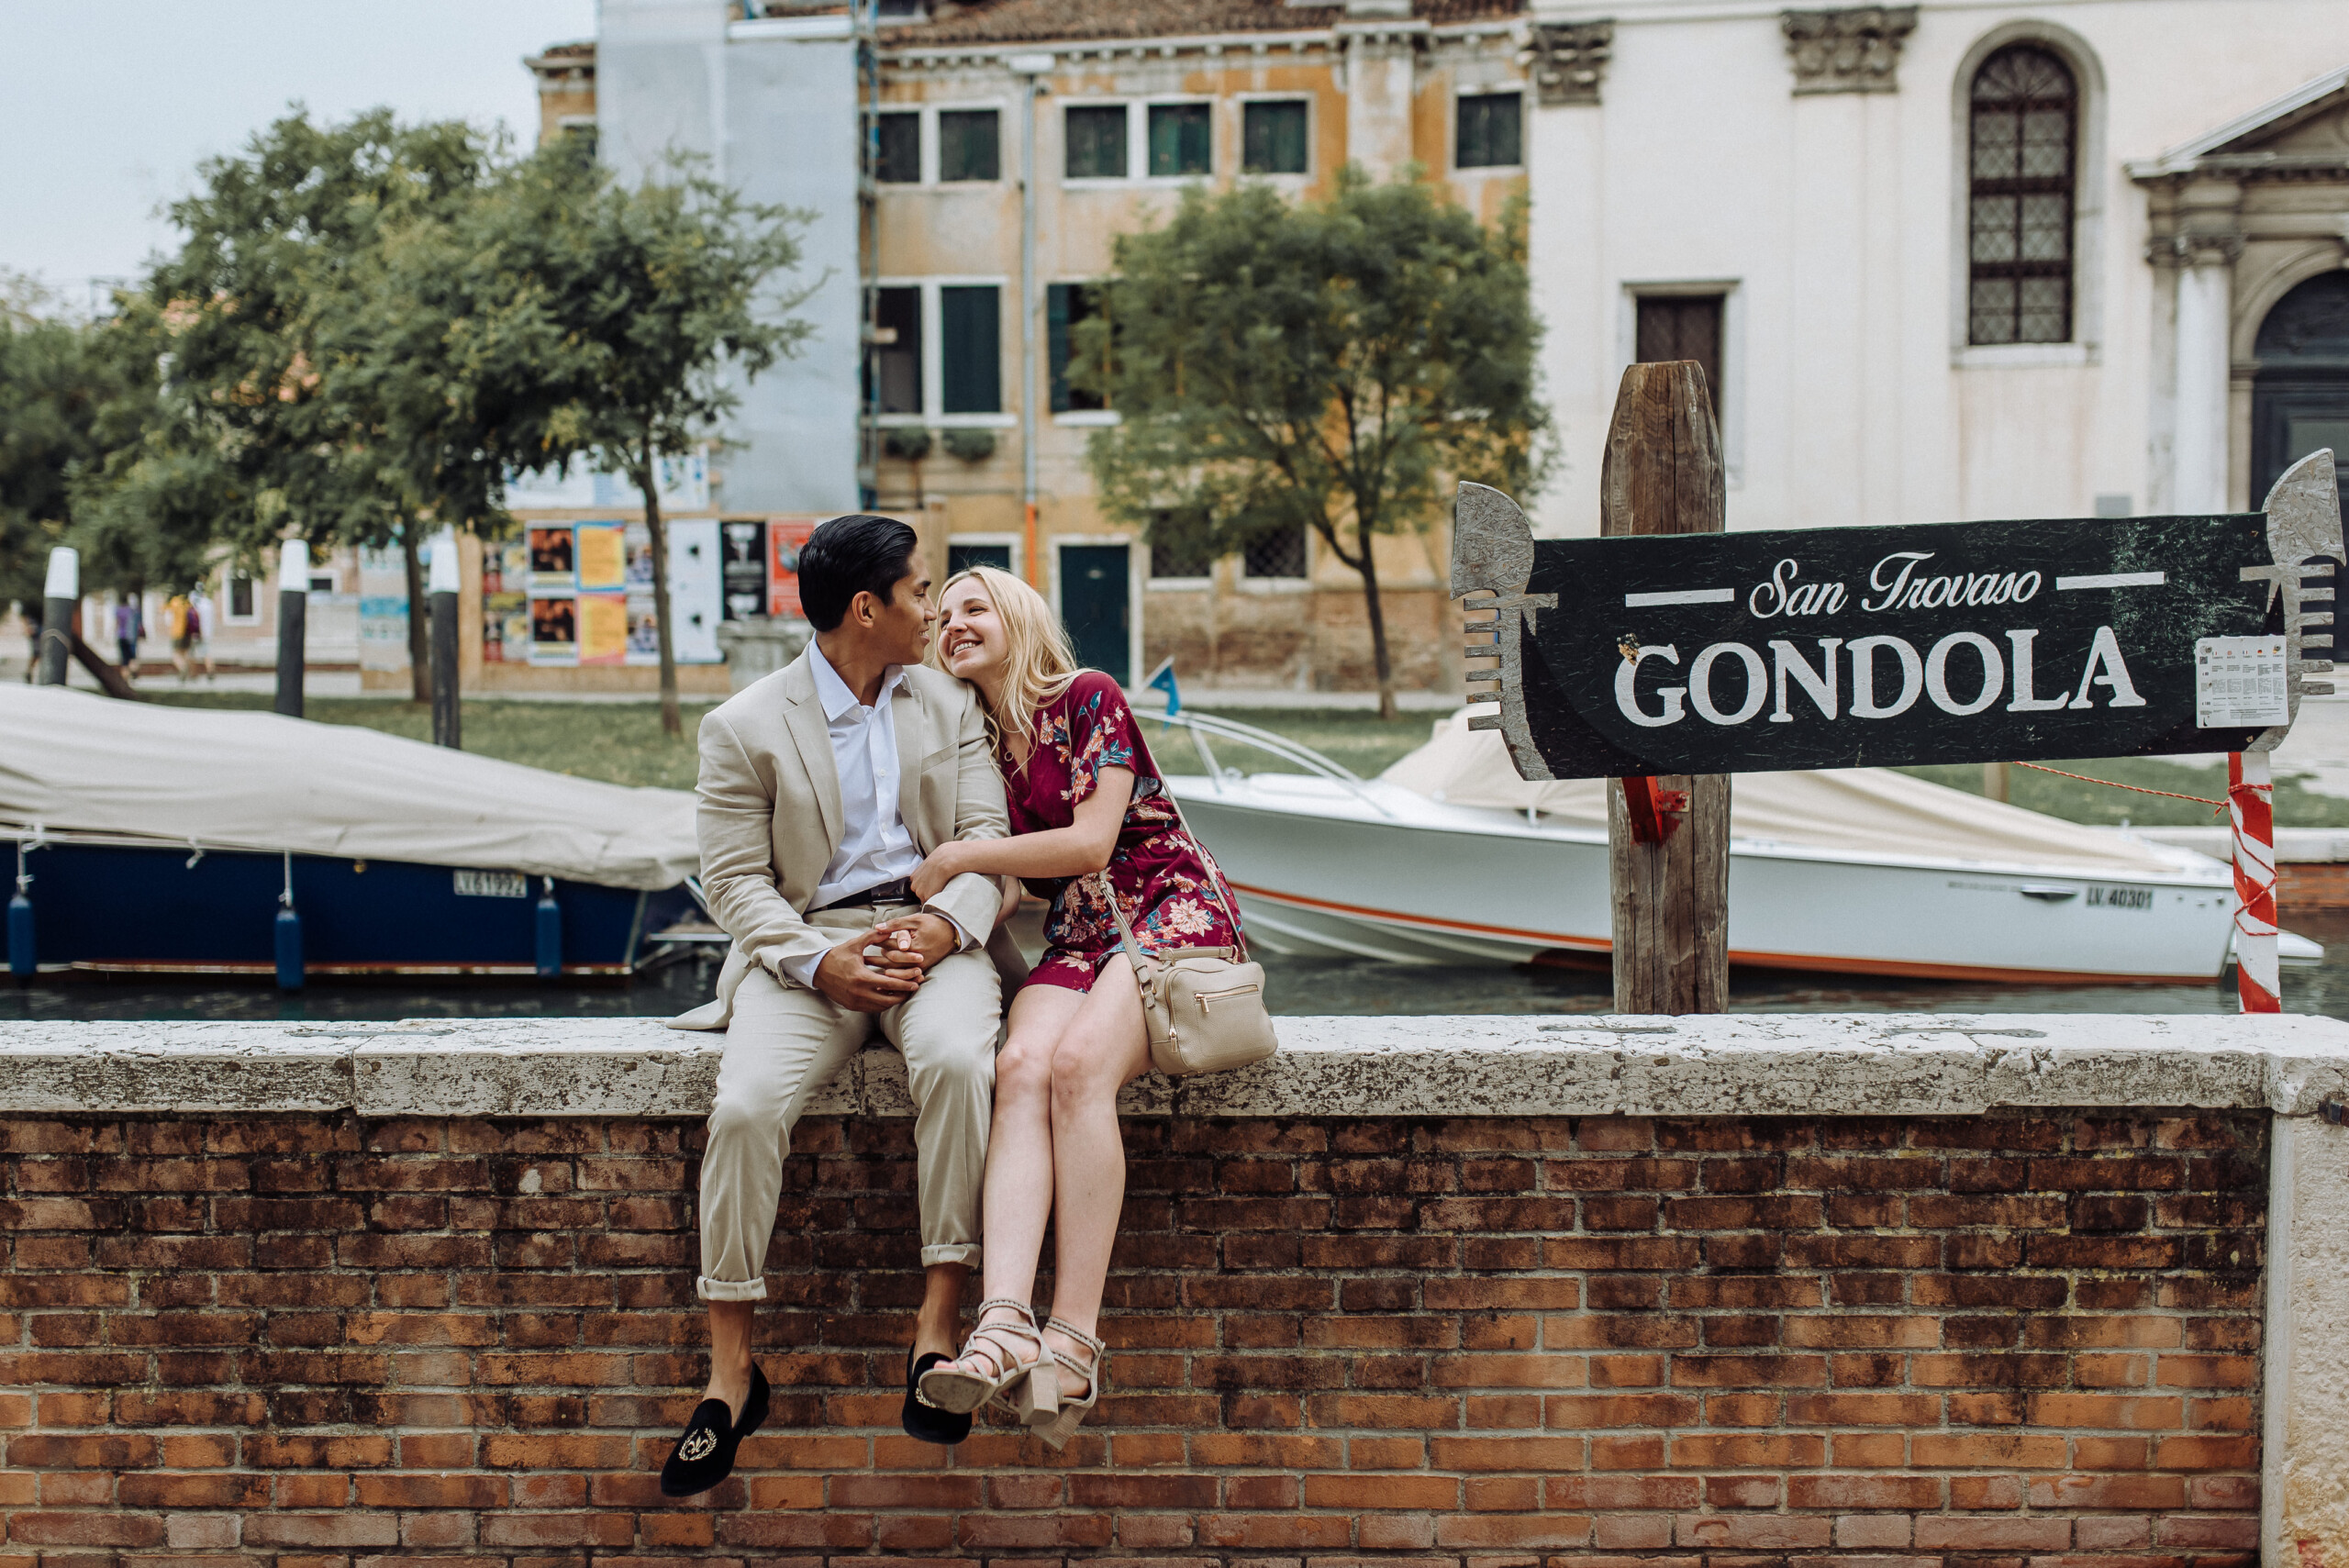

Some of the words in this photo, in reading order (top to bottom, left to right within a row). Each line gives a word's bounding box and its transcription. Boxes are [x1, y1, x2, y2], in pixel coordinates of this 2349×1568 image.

[1749, 558, 1848, 618] San
[1861, 551, 2042, 611] Trovaso
[1614, 625, 2146, 727] GONDOLA
